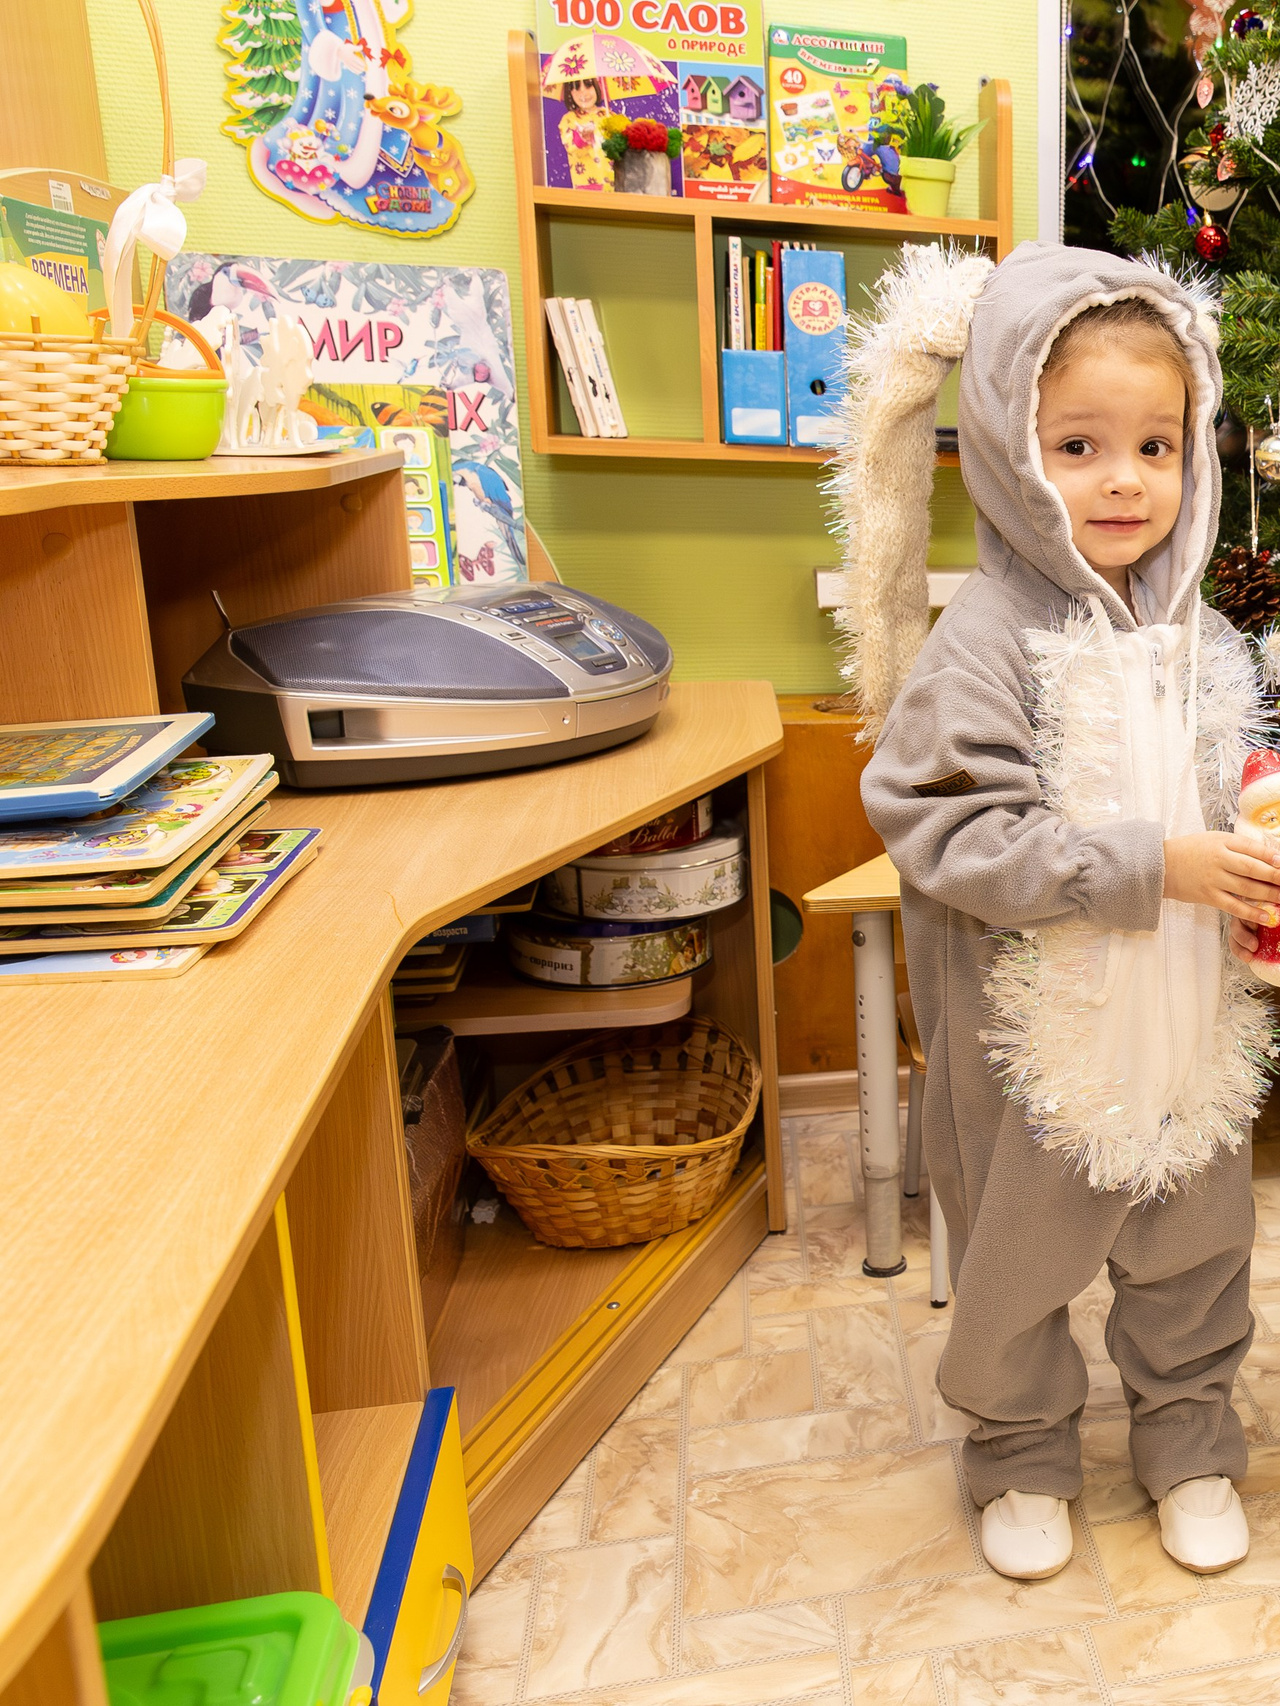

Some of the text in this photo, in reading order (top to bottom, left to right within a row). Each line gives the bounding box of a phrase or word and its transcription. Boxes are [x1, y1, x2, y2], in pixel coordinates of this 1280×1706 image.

[550, 0, 746, 35] 100 СЛОВ
[668, 38, 746, 57] О ПРИРОДЕ
[783, 70, 803, 84] 40
[365, 195, 432, 214] ГОДОМ!
[297, 315, 404, 363] МИР
[528, 956, 574, 972] сюрприз
